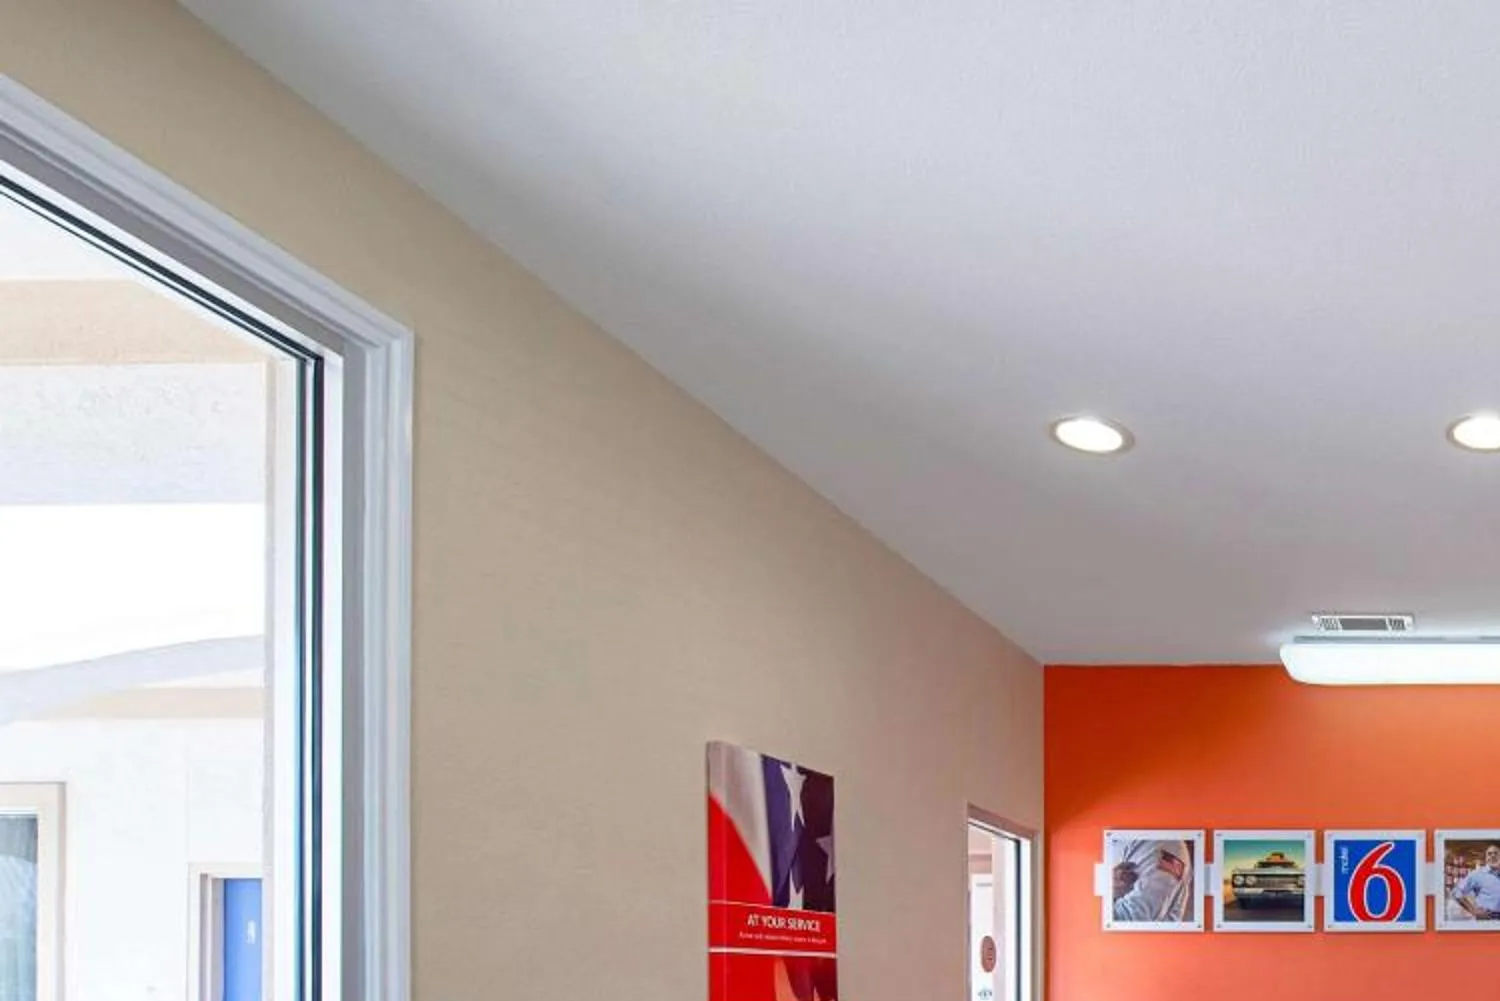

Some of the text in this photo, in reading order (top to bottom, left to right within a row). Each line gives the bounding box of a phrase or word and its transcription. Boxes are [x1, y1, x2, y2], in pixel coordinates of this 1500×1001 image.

[1347, 841, 1406, 923] 6
[747, 913, 821, 932] AT YOUR SERVICE
